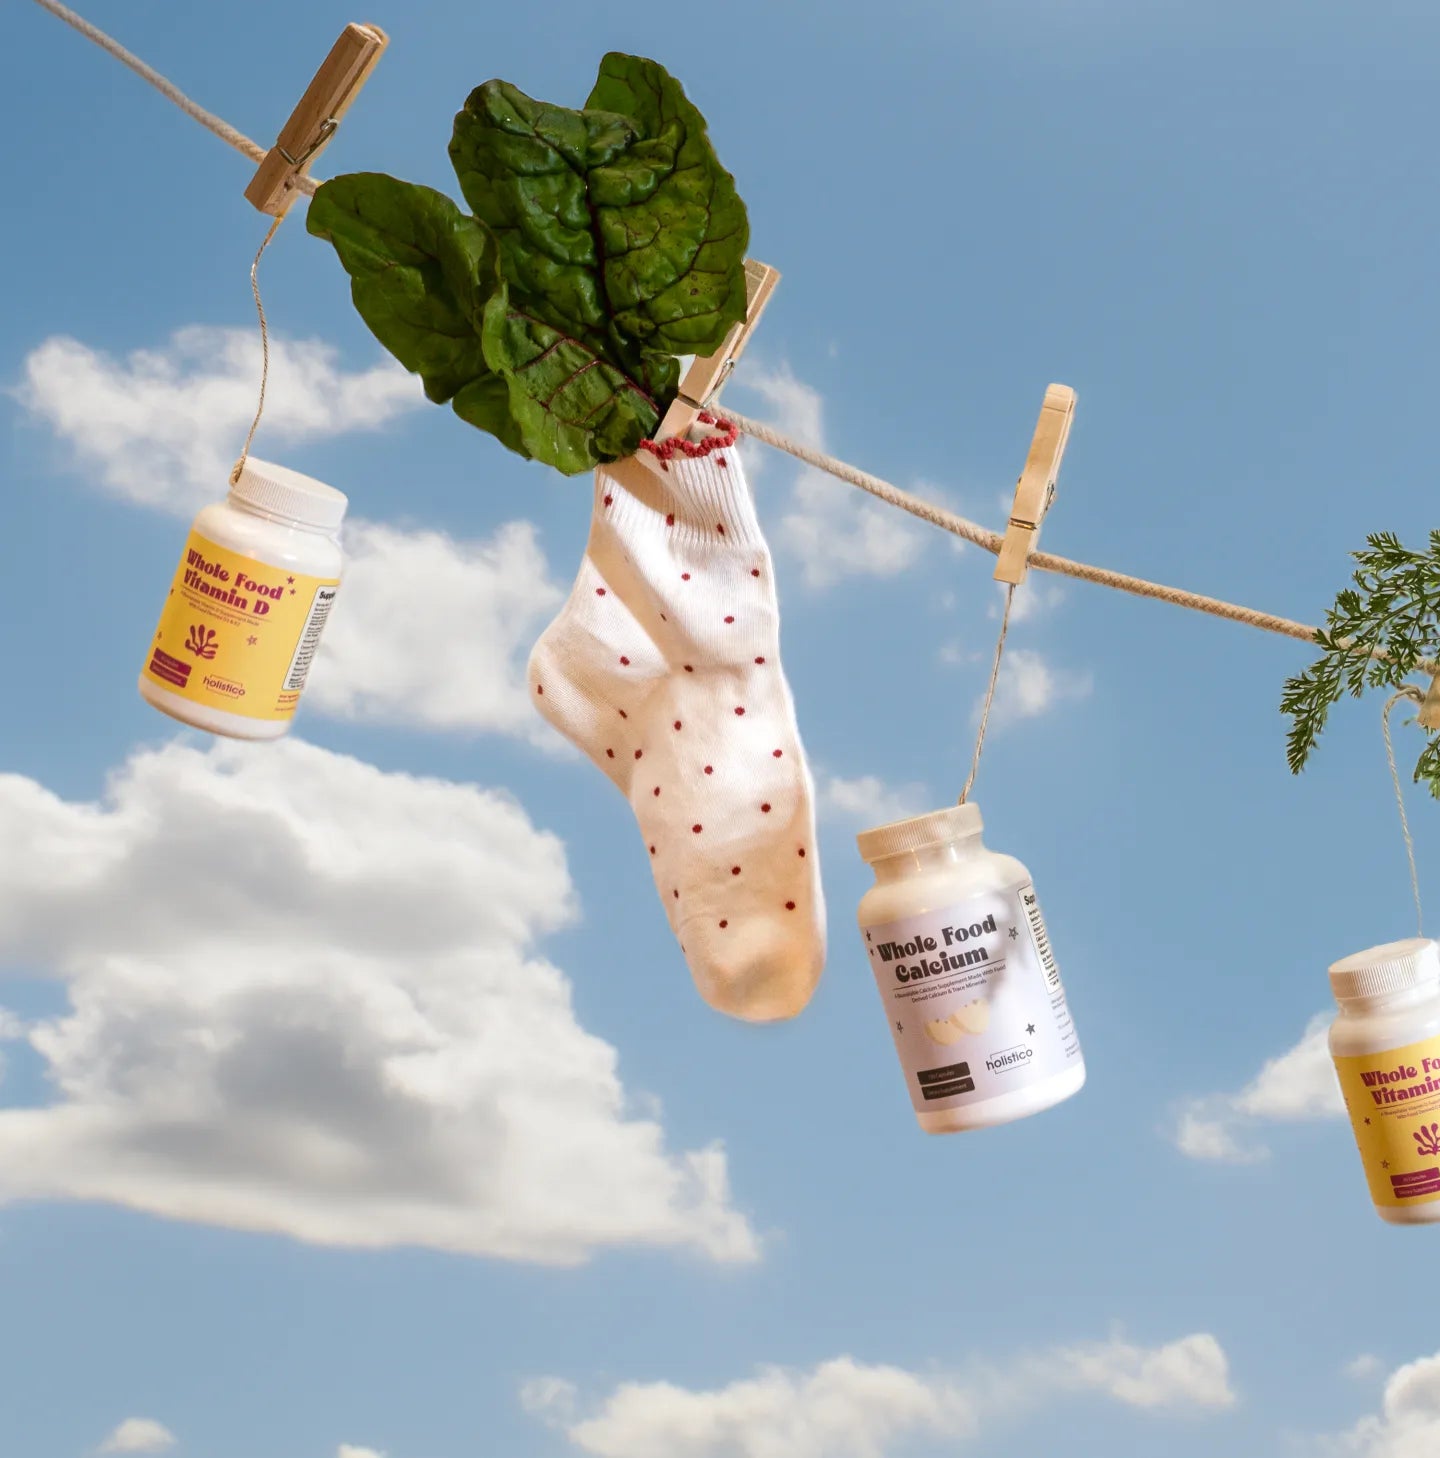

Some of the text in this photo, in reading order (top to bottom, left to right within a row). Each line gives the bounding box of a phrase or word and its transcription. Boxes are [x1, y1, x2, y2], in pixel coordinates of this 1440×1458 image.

[183, 568, 248, 610] Vitamin
[253, 600, 270, 616] D
[187, 548, 284, 600] Whole Food
[202, 676, 246, 696] holistico
[877, 914, 998, 962] Whole Food
[895, 946, 989, 983] Calcium
[986, 1048, 1033, 1071] holistico
[1360, 1065, 1418, 1087] Whole
